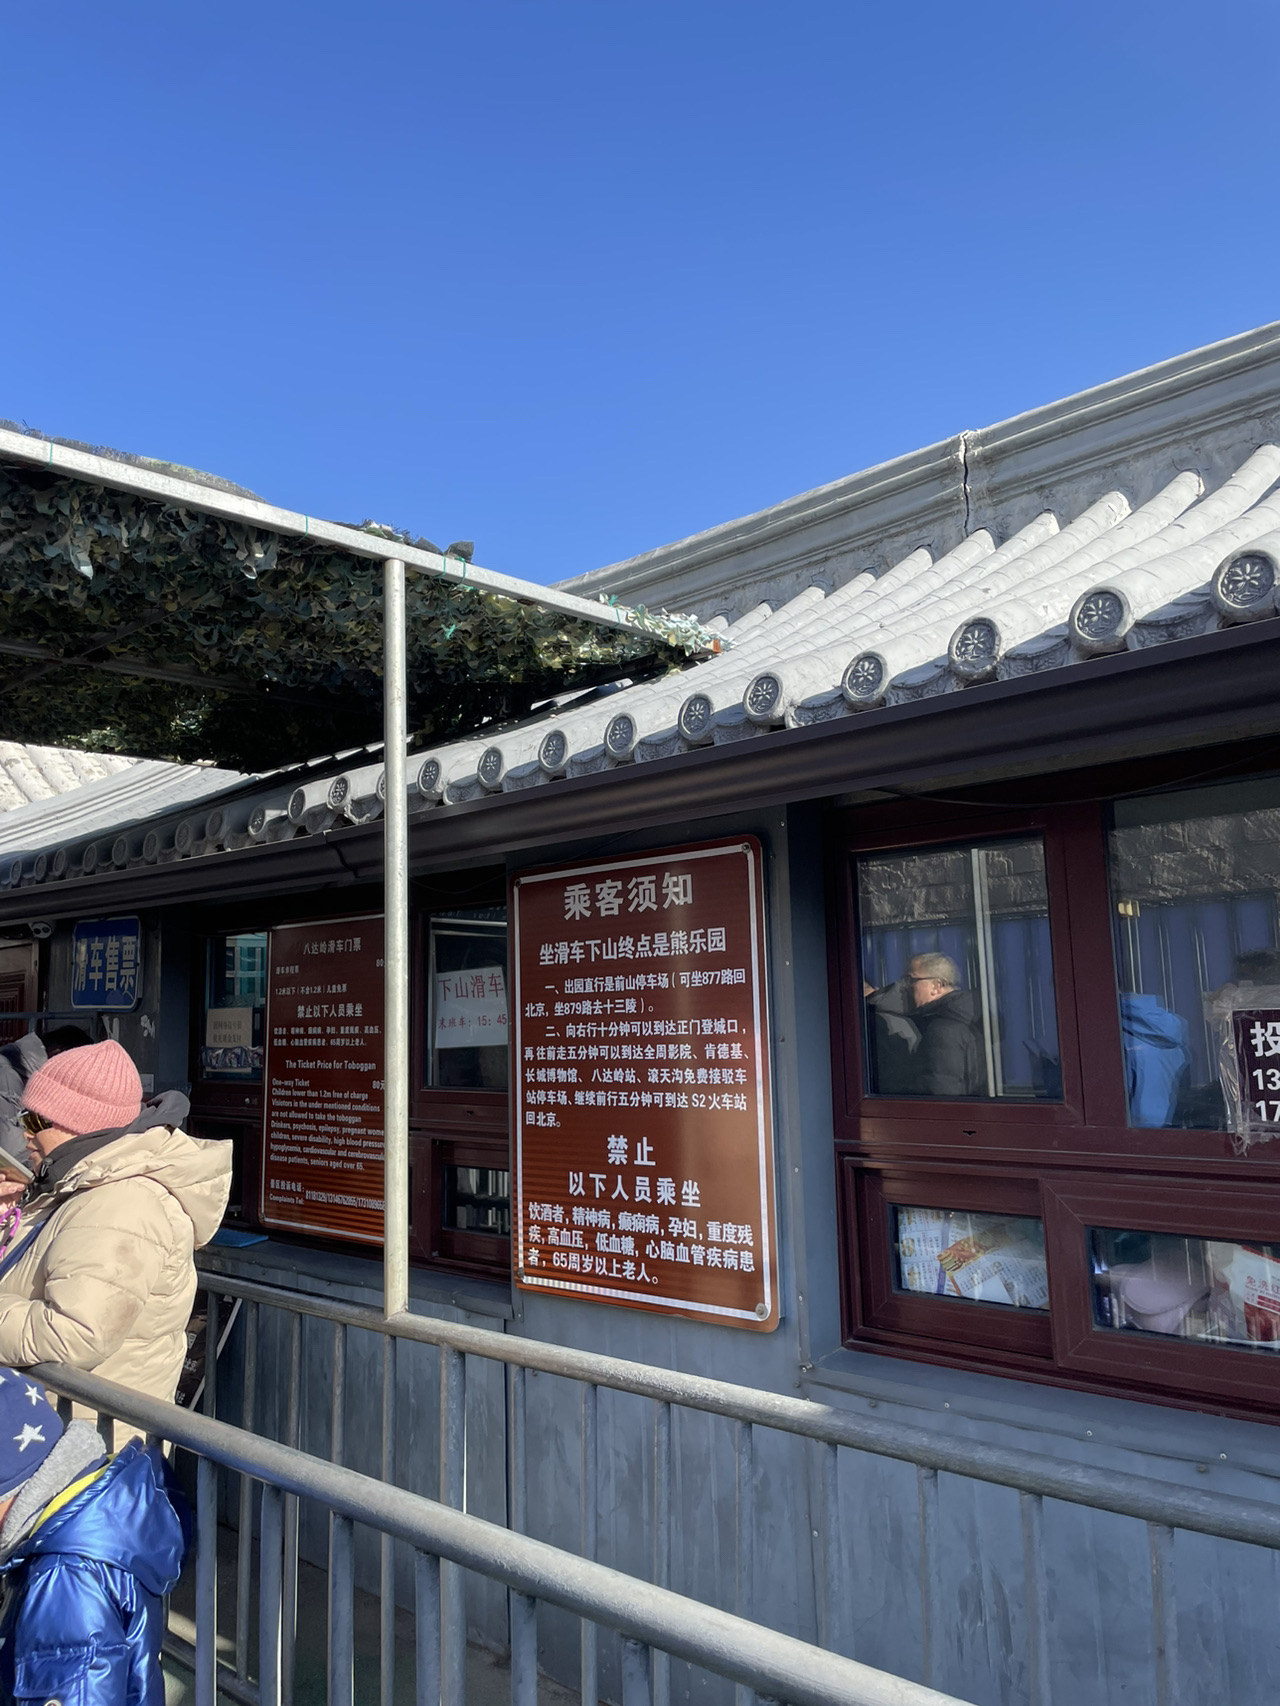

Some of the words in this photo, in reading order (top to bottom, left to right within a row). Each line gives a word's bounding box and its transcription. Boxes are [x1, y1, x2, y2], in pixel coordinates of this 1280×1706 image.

[563, 872, 694, 921] 乘客须知
[303, 937, 362, 955] 八达岭滑车门票
[539, 927, 727, 966] 坐滑车下山终点是熊乐园
[74, 935, 137, 991] 滑车售票
[437, 973, 504, 1002] 下山滑车
[297, 1003, 363, 1019] 禁止以下人员乘坐
[286, 1060, 296, 1069] The
[298, 1060, 315, 1069] Ticket
[317, 1060, 332, 1069] Price
[333, 1060, 342, 1069] for
[344, 1060, 376, 1072] Toboggan
[272, 1078, 294, 1088] One-way
[295, 1079, 309, 1087] Ticket
[272, 1088, 291, 1096] Children
[307, 1090, 318, 1098] than
[319, 1090, 332, 1098] 1.2m
[333, 1090, 343, 1099] free
[343, 1090, 350, 1099] of
[350, 1091, 368, 1101] charge
[299, 1100, 307, 1108] the
[352, 1103, 380, 1112] conditions
[289, 1111, 307, 1119] allowed
[315, 1112, 326, 1120] take
[327, 1112, 336, 1121] the
[336, 1114, 362, 1124] toboggan
[525, 1111, 561, 1128] 回北京。
[342, 1127, 366, 1136] pregnant
[333, 1136, 345, 1146] high
[346, 1138, 362, 1146] blood
[337, 1149, 347, 1157] and
[607, 1134, 656, 1166] 禁止
[330, 1160, 342, 1169] aged
[568, 1171, 701, 1208] 以下人员乘坐
